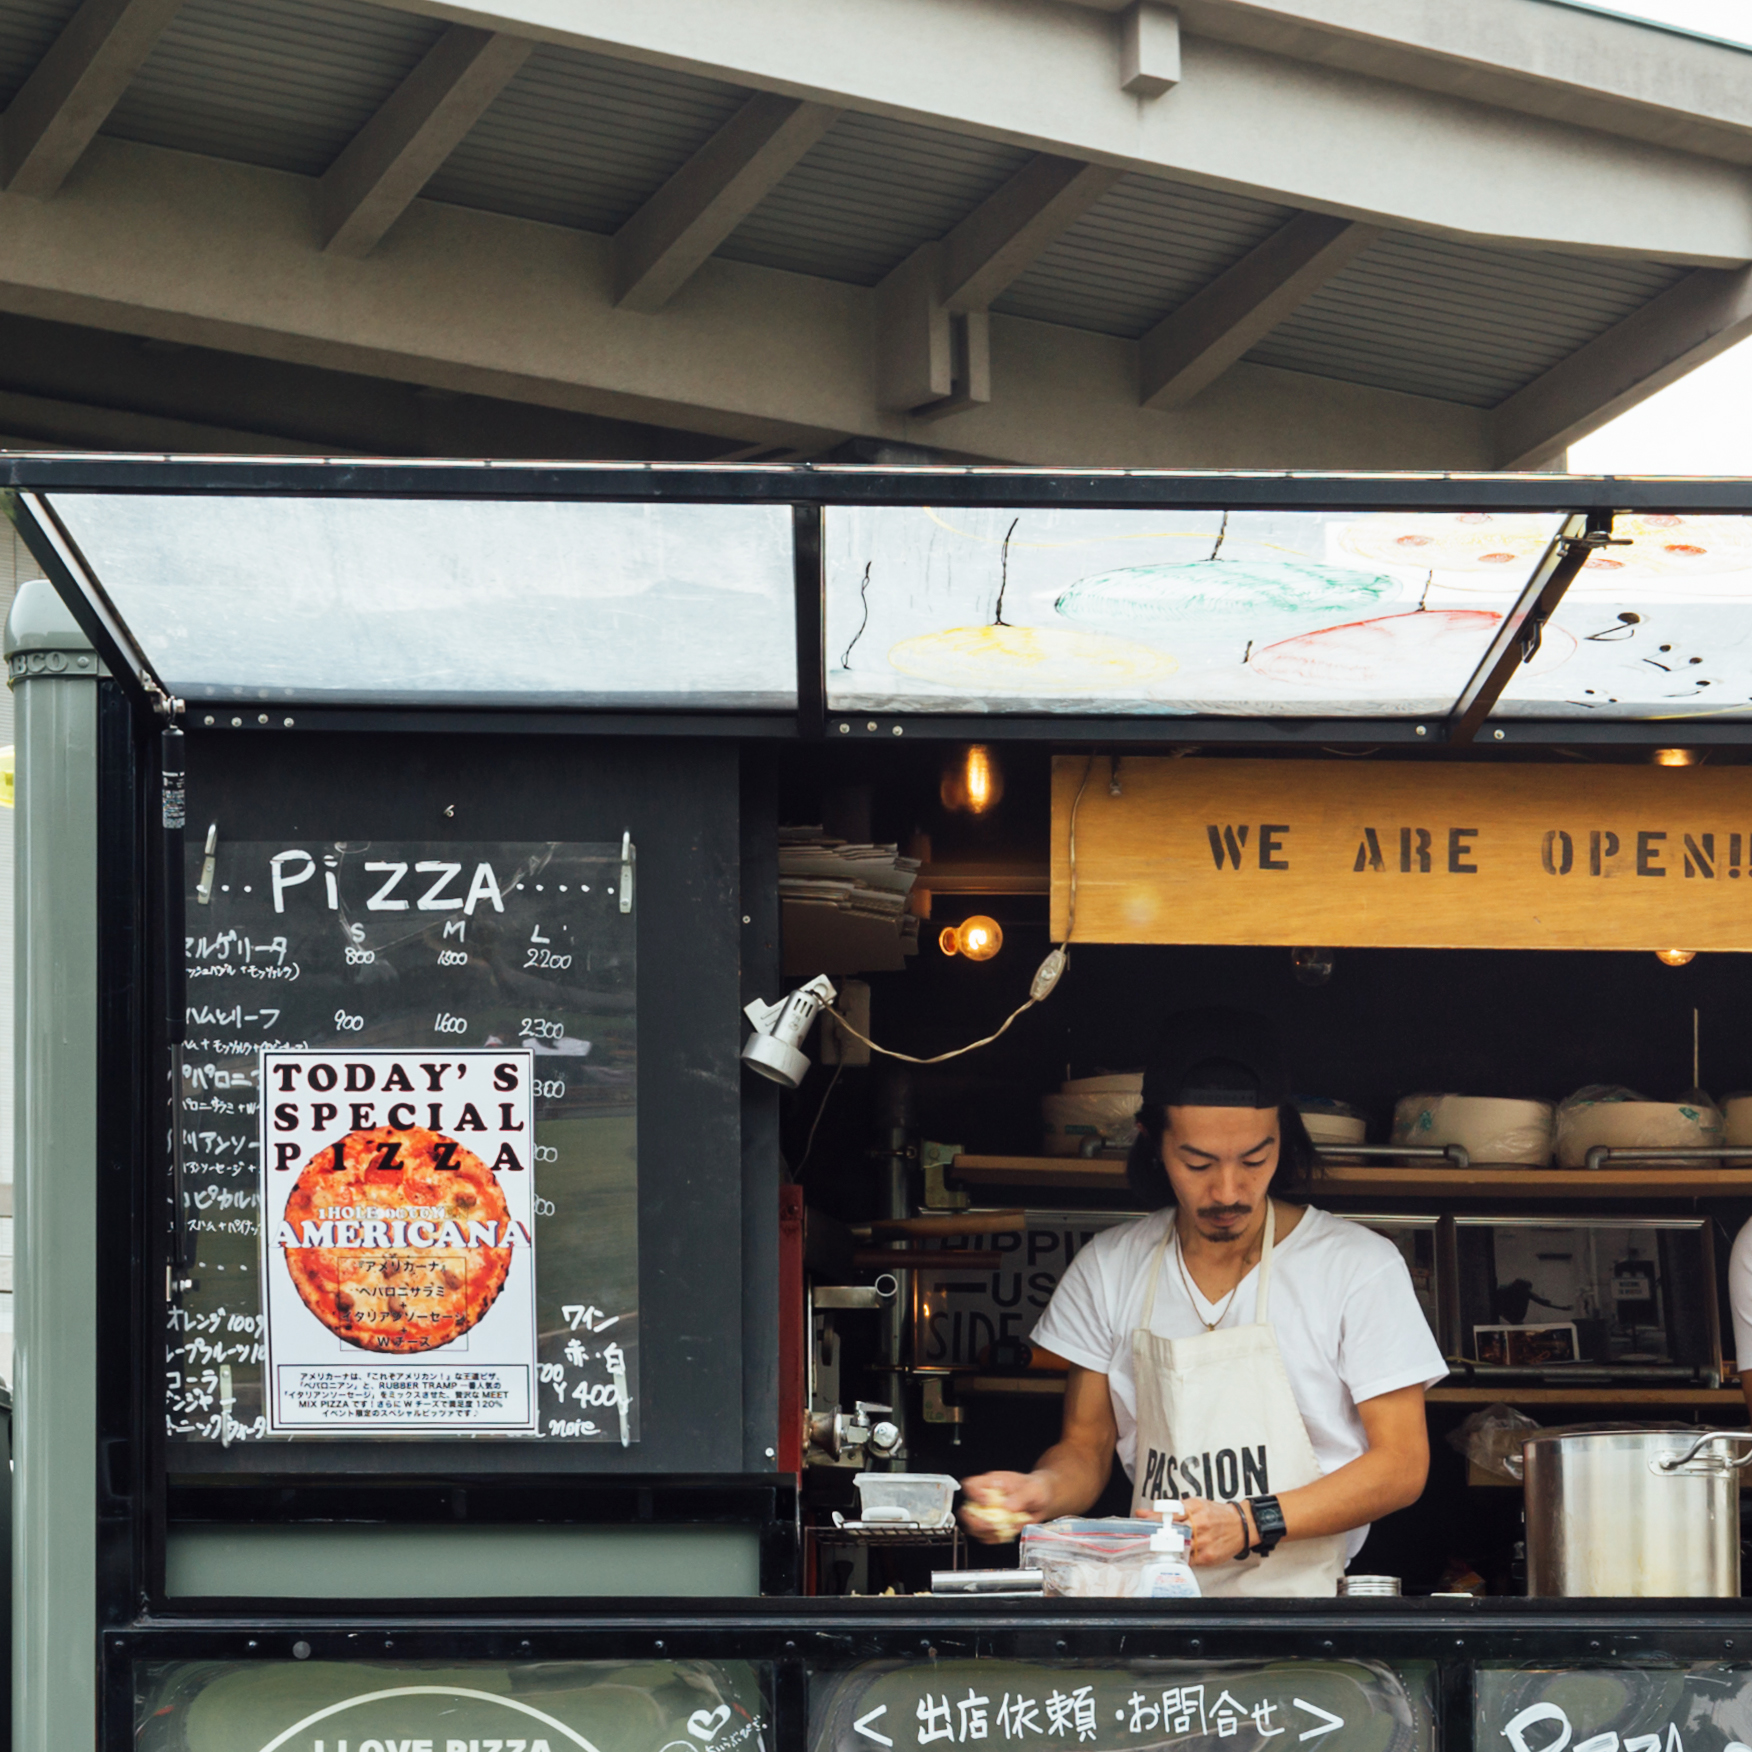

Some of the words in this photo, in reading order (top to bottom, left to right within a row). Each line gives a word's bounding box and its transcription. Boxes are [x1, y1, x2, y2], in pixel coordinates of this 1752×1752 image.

[1207, 823, 1291, 873] WE
[1352, 826, 1480, 875] ARE
[353, 923, 366, 941] S
[444, 921, 464, 942] M
[531, 925, 550, 944] L
[345, 948, 375, 965] 800
[334, 1013, 364, 1031] 900
[435, 1012, 468, 1034] 1600
[274, 1103, 524, 1131] SPECIAL
[274, 1142, 524, 1171] PIZZA
[269, 1220, 531, 1248] AMERICANA
[1141, 1444, 1269, 1501] PASSION
